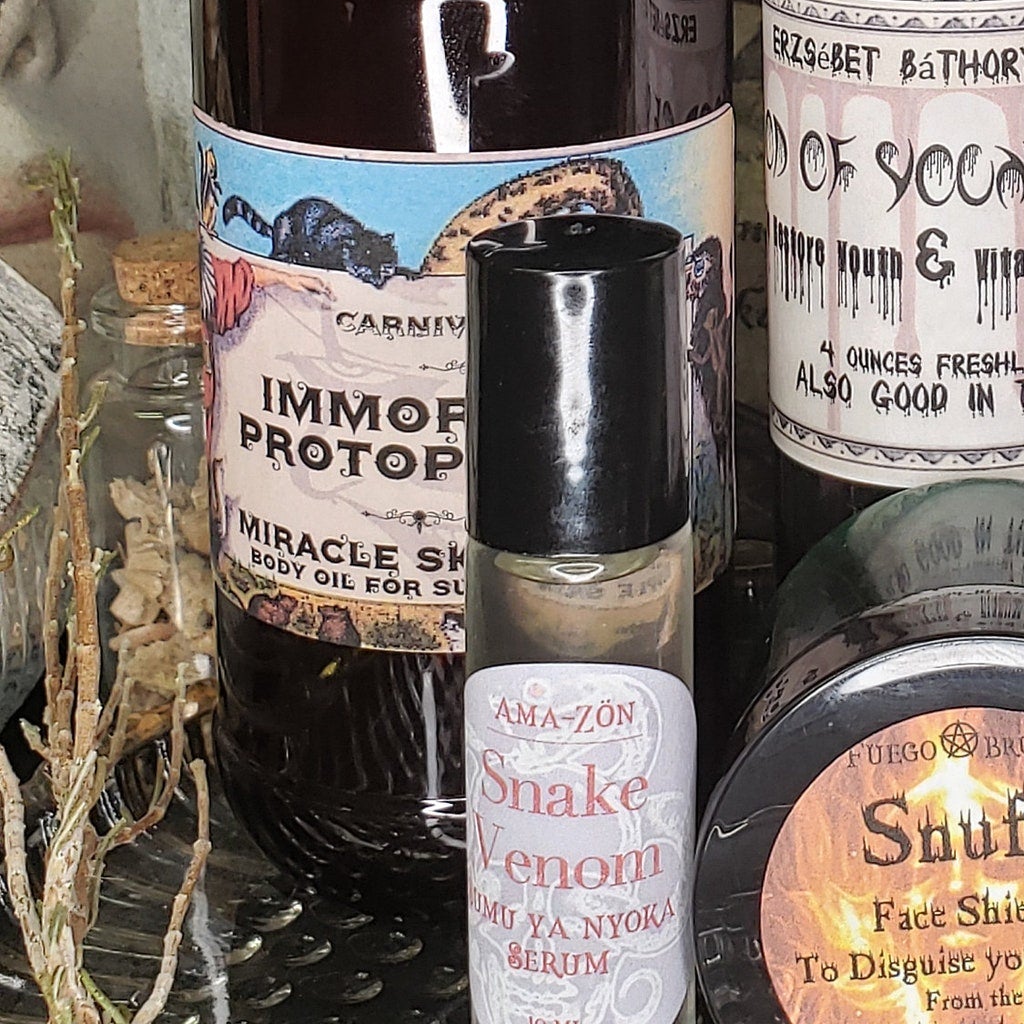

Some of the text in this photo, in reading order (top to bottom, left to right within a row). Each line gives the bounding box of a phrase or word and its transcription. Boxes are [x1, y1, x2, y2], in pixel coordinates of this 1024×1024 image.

[800, 129, 857, 200] OF
[915, 227, 954, 289] &
[336, 311, 465, 340] CARNIV
[819, 340, 835, 367] 4
[847, 346, 922, 378] OUNCES
[795, 360, 852, 408] ALSO
[871, 379, 949, 418] GOOD
[968, 382, 995, 418] IN
[239, 412, 464, 481] PROTOP
[239, 507, 400, 578] MIRACLE
[251, 546, 306, 580] BODY
[314, 568, 355, 591] OIL
[365, 577, 422, 599] FOR
[494, 696, 636, 734] AMA-ZÖN
[846, 740, 937, 768] FUEGO
[481, 749, 650, 817] Snake
[473, 810, 665, 890] Venom
[527, 913, 571, 940] YA
[582, 898, 676, 940] NYOKA
[873, 895, 946, 933] Face
[508, 941, 611, 979] SERUM
[795, 950, 839, 984] To
[850, 949, 975, 986] Disguise
[926, 984, 1024, 1012] From the
